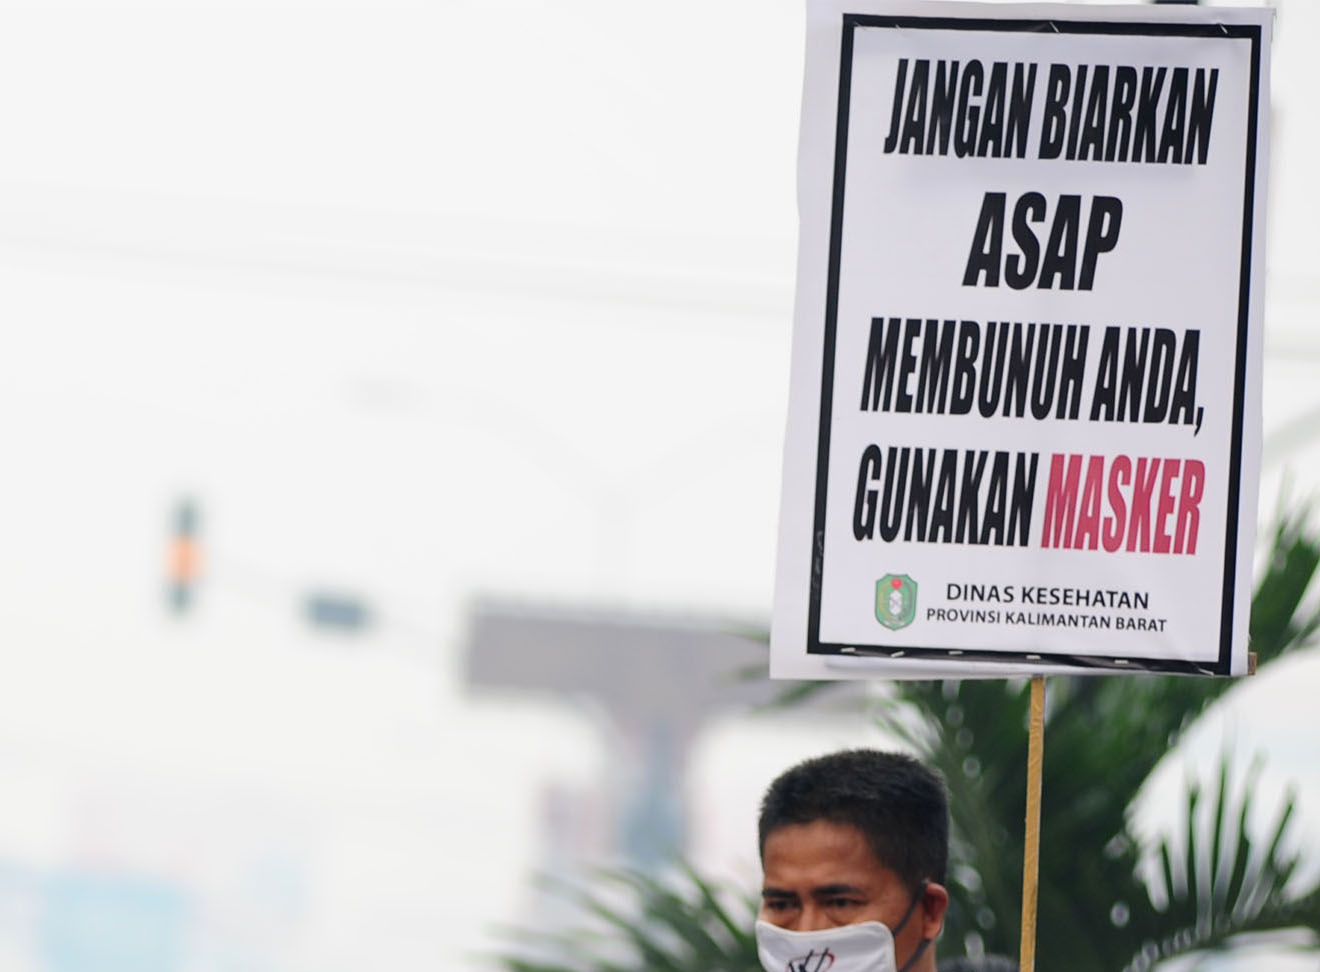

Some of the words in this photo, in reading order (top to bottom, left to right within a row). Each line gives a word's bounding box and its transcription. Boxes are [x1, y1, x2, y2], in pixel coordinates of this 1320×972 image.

[883, 58, 1039, 160] JANGAN
[1037, 63, 1220, 166] BIARKAN
[961, 191, 1124, 292] ASAP
[859, 316, 1091, 422] MEMBUNUH
[1088, 325, 1205, 437] ANDA,
[852, 443, 1040, 548] GUNAKAN
[1040, 453, 1206, 555] MASKER
[926, 608, 1001, 624] PROVINSI
[1005, 611, 1111, 629] KALIMANTAN
[1115, 616, 1167, 632] BARAT
[946, 583, 1015, 604] DINAS
[1021, 586, 1149, 610] KESEHATAN
